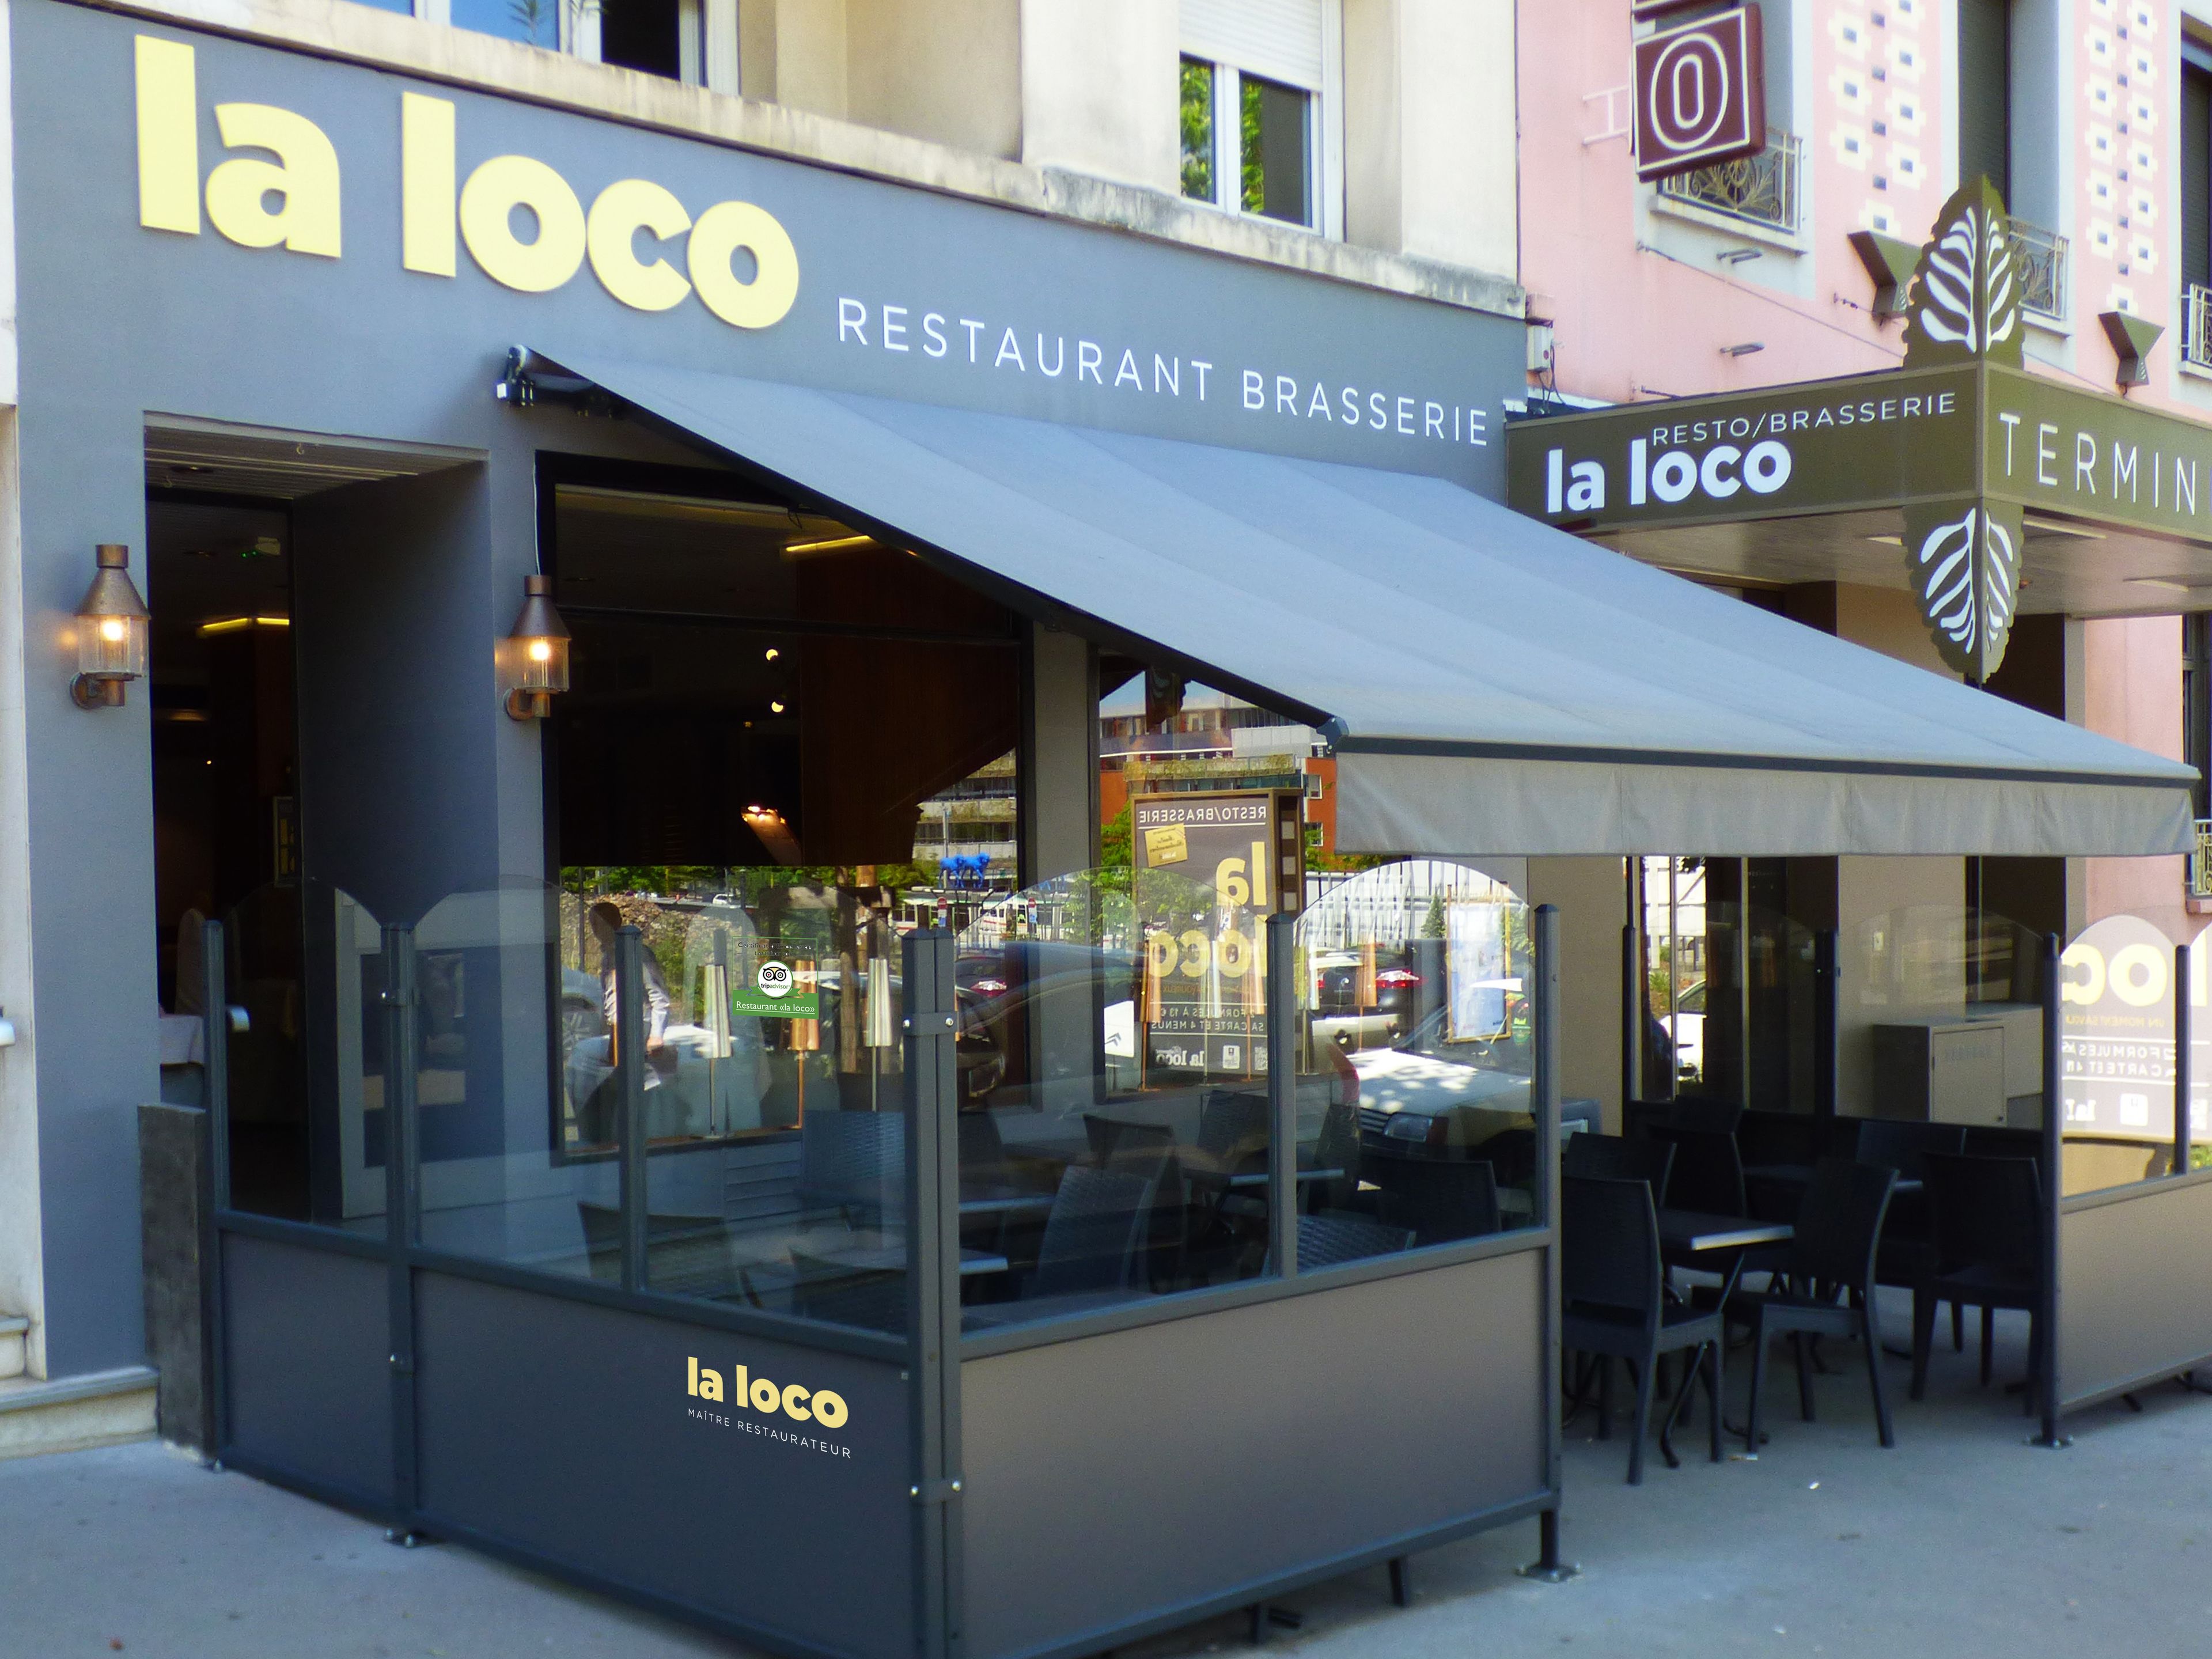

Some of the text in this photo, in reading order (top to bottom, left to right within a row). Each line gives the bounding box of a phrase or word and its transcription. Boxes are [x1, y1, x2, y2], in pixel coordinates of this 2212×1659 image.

[134, 35, 800, 329] la loco
[837, 296, 1488, 446] RESTAURANT BRASSERIE
[1652, 392, 1956, 448] RESTO/BRASSERIE
[1547, 438, 1792, 514] la loco
[1999, 412, 2212, 516] TERMIN
[736, 1001, 778, 1011] Restaurant
[687, 1356, 849, 1429] la loco
[688, 1407, 851, 1459] MAÎTRE RESTAURATEUR
